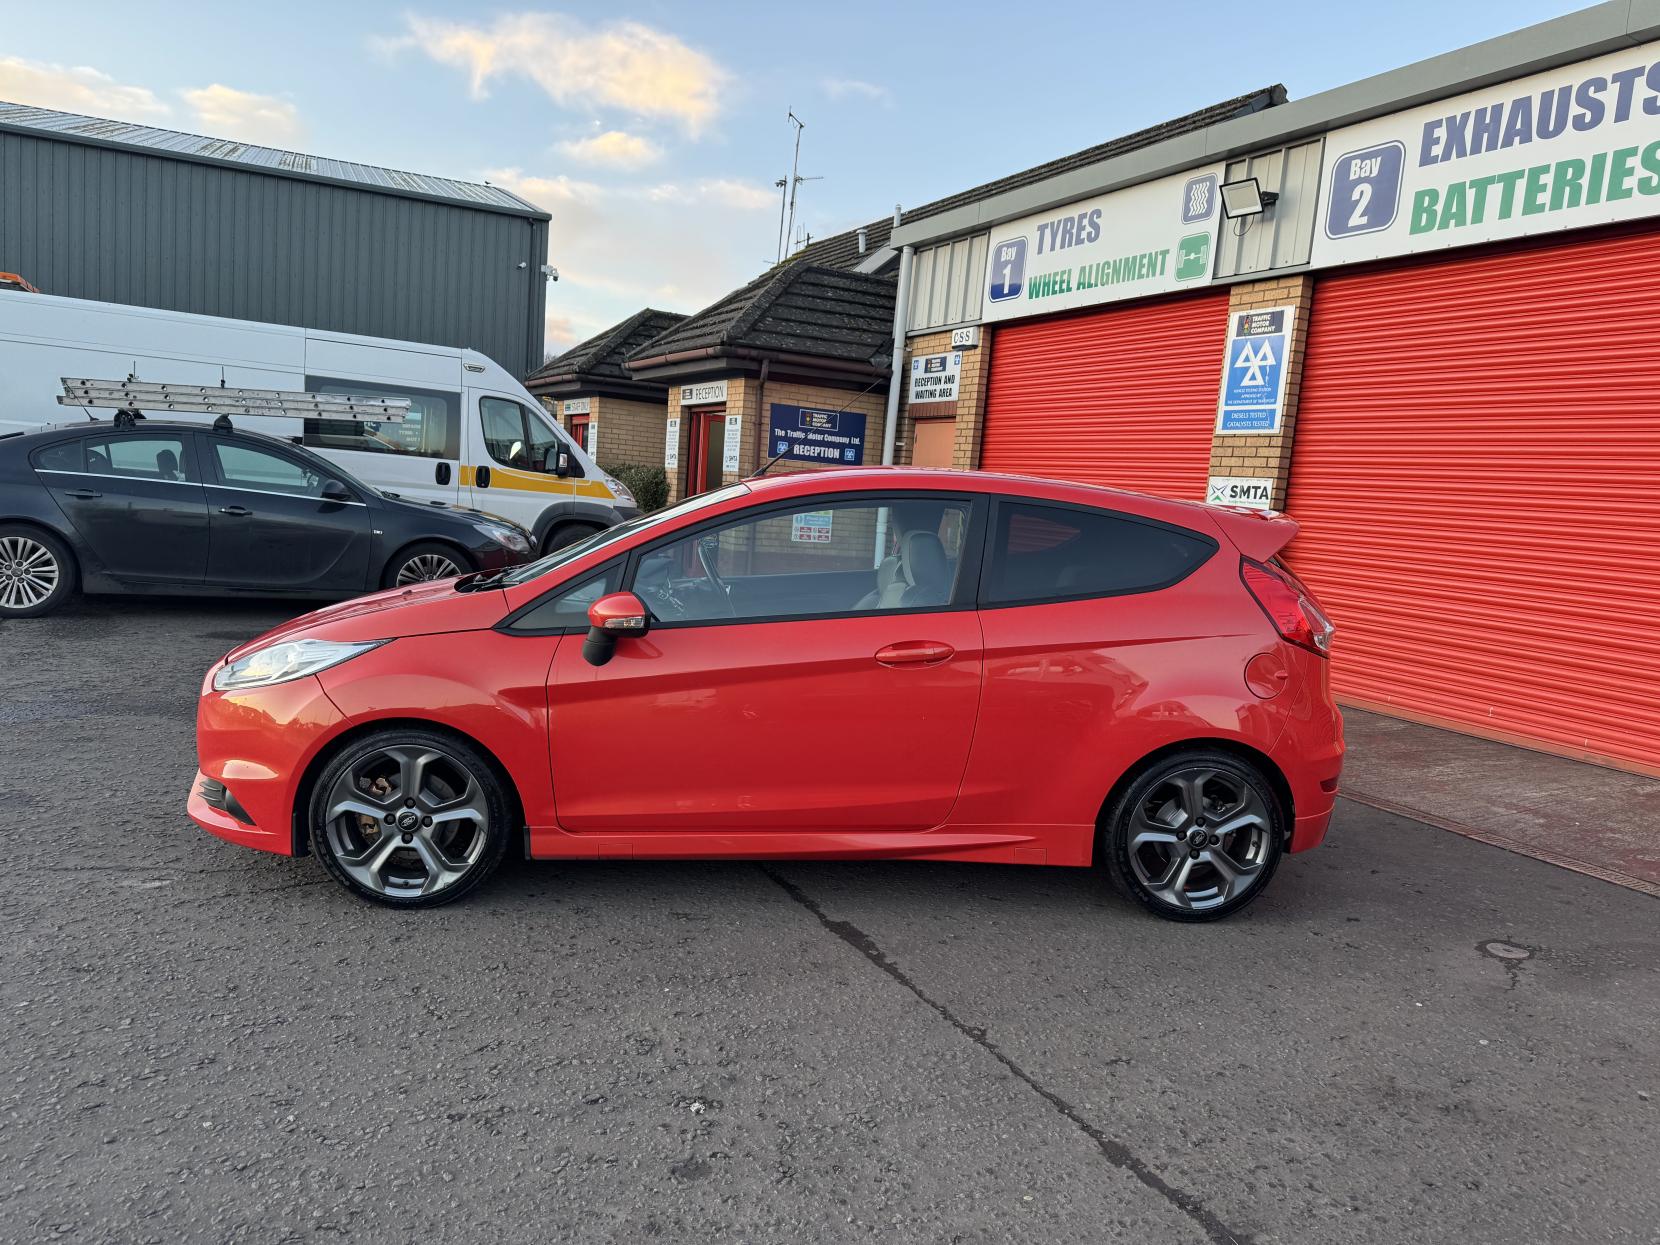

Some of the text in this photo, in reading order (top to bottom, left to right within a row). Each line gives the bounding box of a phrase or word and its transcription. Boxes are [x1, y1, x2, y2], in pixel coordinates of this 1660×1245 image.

[1349, 155, 1381, 181] Bay
[1408, 139, 1660, 236] BATTERIES
[1347, 182, 1373, 228] 2
[1036, 208, 1103, 255] TYRES
[1001, 246, 1017, 263] Bay
[1001, 264, 1011, 294] 1
[1028, 248, 1170, 300] WHEEL ALIGNMENT
[1251, 320, 1270, 328] MOTOR
[1252, 314, 1272, 322] TRAFFIC
[953, 331, 970, 344] CSS
[1250, 325, 1275, 334] COMPANY
[915, 374, 955, 387] RECEPTION AND
[695, 385, 724, 401] RECEPTION
[915, 387, 953, 400] WAITING AREA
[1227, 420, 1252, 428] CATALYSTS
[774, 428, 785, 437] The
[787, 430, 806, 439] Traffic
[807, 432, 823, 441] Motor
[824, 434, 850, 444] Company
[793, 444, 840, 459] RECEPTION
[1229, 484, 1269, 500] SMTA
